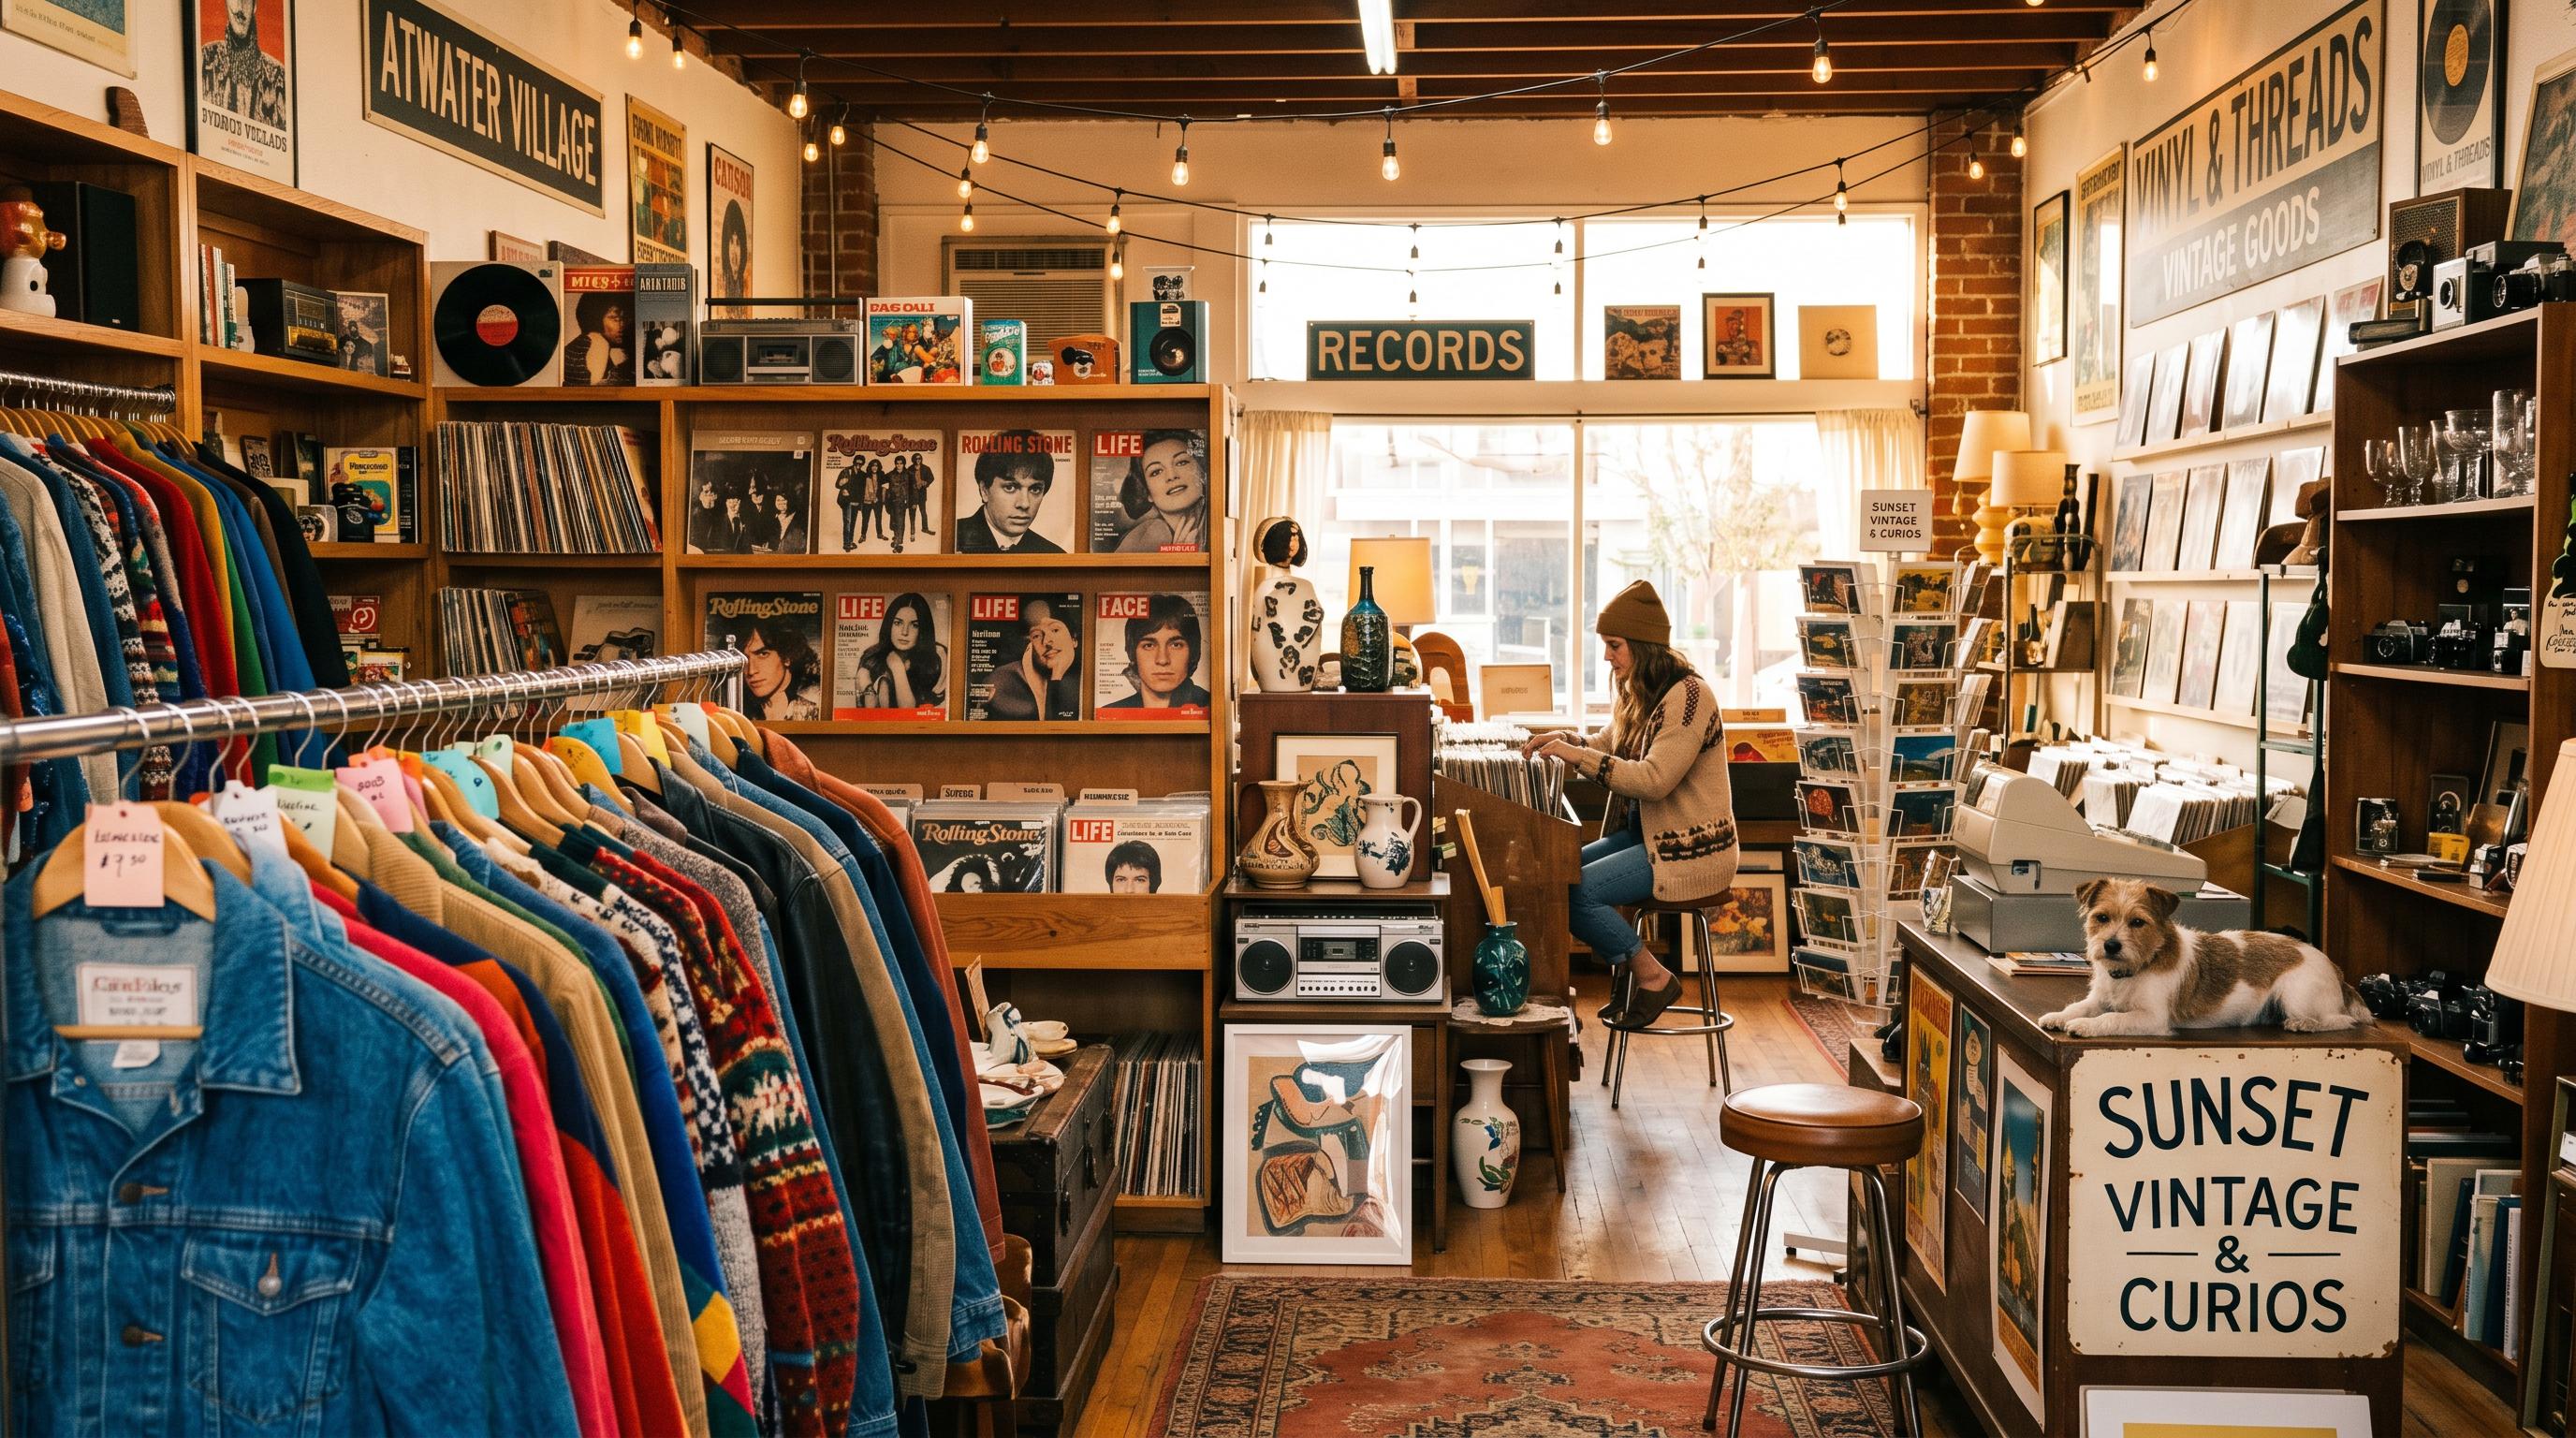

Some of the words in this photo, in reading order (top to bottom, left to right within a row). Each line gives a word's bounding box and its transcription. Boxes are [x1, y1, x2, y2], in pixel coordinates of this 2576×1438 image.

[380, 10, 503, 144] ATWATER
[508, 73, 596, 187] VILLAGE
[2135, 124, 2200, 237] VINYL
[2206, 108, 2224, 208] &
[2231, 15, 2373, 195] THREADS
[2162, 222, 2237, 302] VINTAGE
[2245, 185, 2320, 270] GOODS
[1317, 329, 1526, 372] RECORDS
[961, 433, 1023, 454] ROLLING
[1026, 434, 1073, 454] STONE
[1097, 434, 1142, 454] LIFE
[1871, 502, 1917, 513] SUNSET
[1869, 516, 1918, 526] VINTAGE
[1869, 528, 1877, 539] &
[1880, 528, 1923, 539] CURIOS
[840, 597, 883, 619] LIFE
[973, 597, 1017, 619] LIFE
[921, 822, 990, 846] Rolling
[1071, 821, 1113, 842] LIFE
[2098, 1075, 2370, 1159] SUNSET
[2103, 1175, 2361, 1235] VINTAGE
[2214, 1235, 2250, 1274] &
[2119, 1276, 2348, 1334] CURIOS
